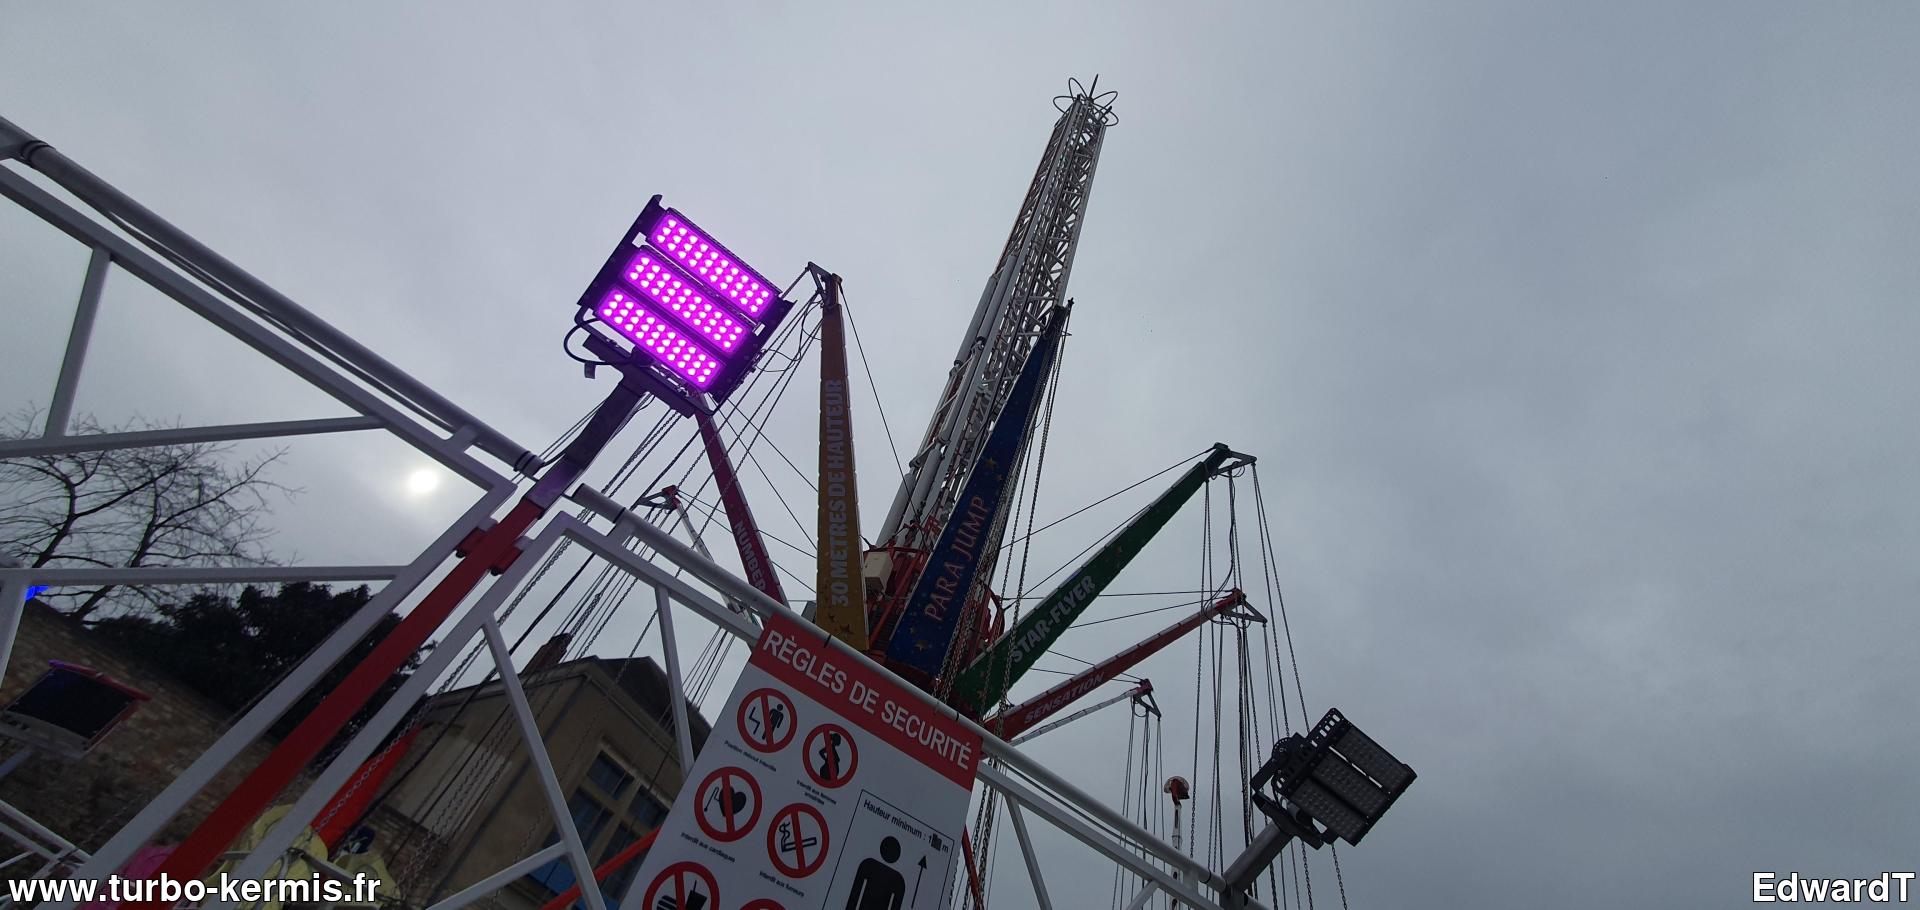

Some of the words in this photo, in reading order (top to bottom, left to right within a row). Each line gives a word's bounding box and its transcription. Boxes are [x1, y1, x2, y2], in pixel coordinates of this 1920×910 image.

[825, 379, 846, 469] HAUTEUR
[828, 471, 847, 497] DE
[734, 521, 767, 591] NUMBER
[829, 501, 849, 578] METRES
[924, 560, 959, 622] PARA
[954, 495, 991, 564] JUMP
[830, 582, 849, 606] 30
[1011, 575, 1096, 663] STAR-FLYER
[763, 629, 848, 694] RÈGLES
[848, 680, 880, 714] DE
[881, 699, 972, 771] SECURITÉ
[1024, 672, 1105, 724] SENSATION
[863, 799, 891, 820] Hauteur
[891, 816, 922, 839] minimum
